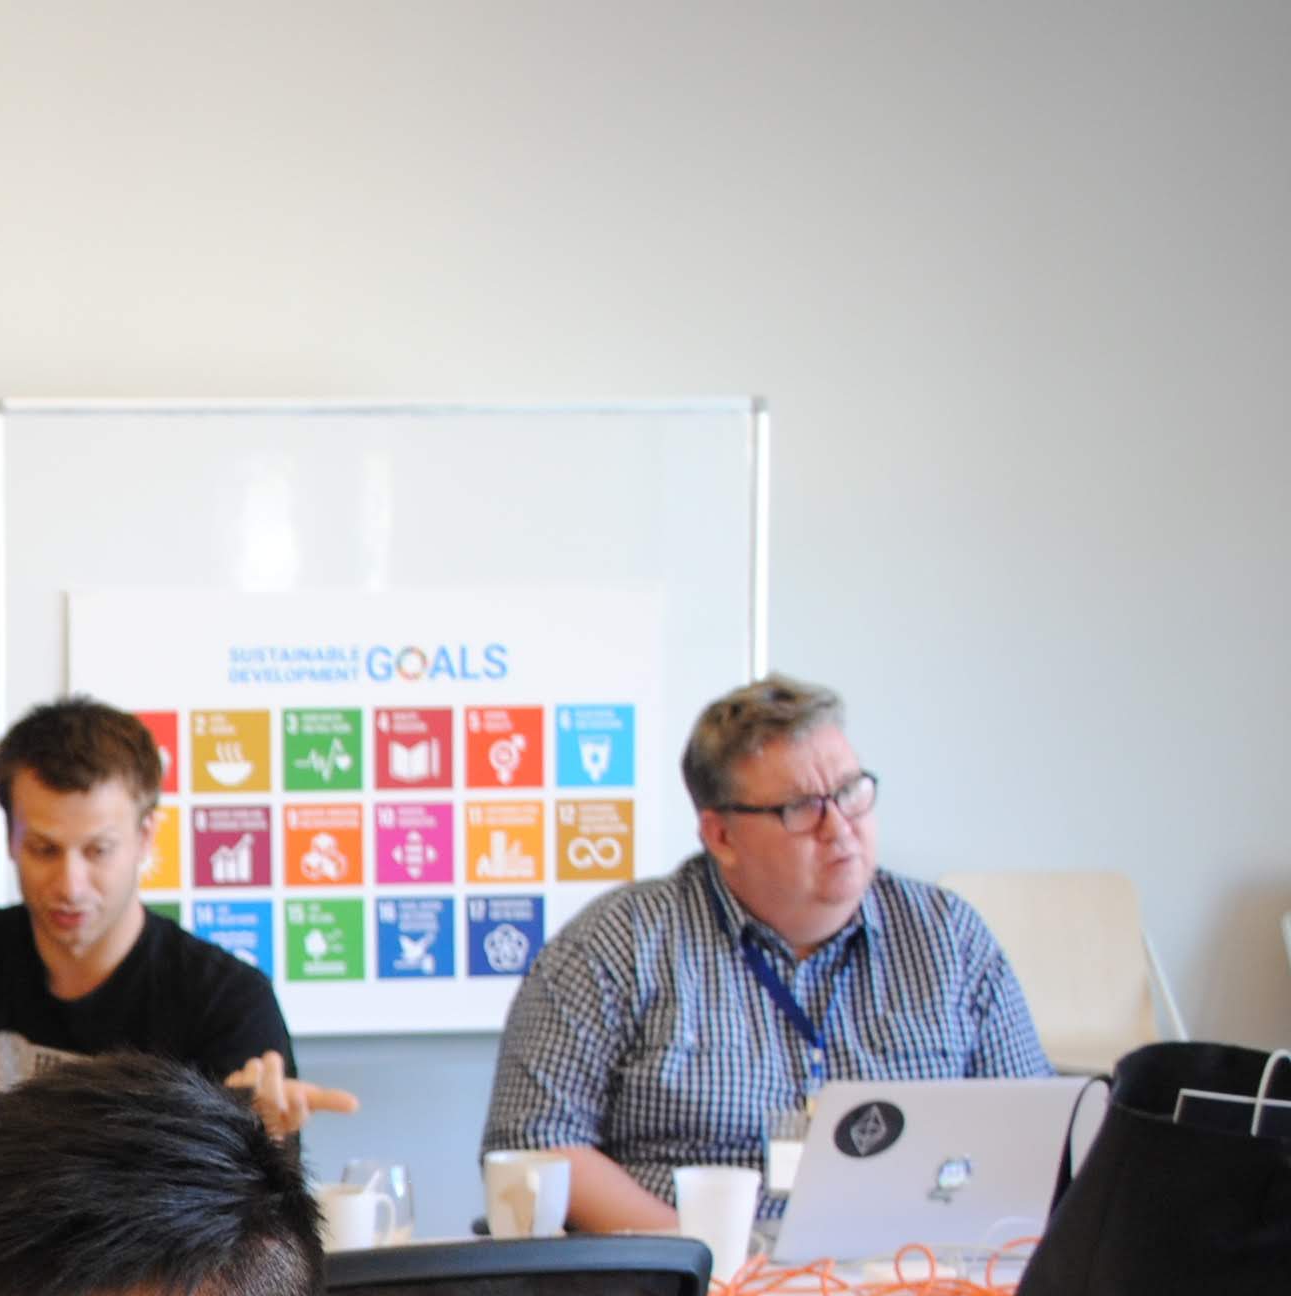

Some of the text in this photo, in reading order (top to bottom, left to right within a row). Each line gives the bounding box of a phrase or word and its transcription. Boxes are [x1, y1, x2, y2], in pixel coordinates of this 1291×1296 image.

[228, 643, 509, 683] SUSTAINABLE GOALS
[228, 666, 360, 685] DEVELOPMENT
